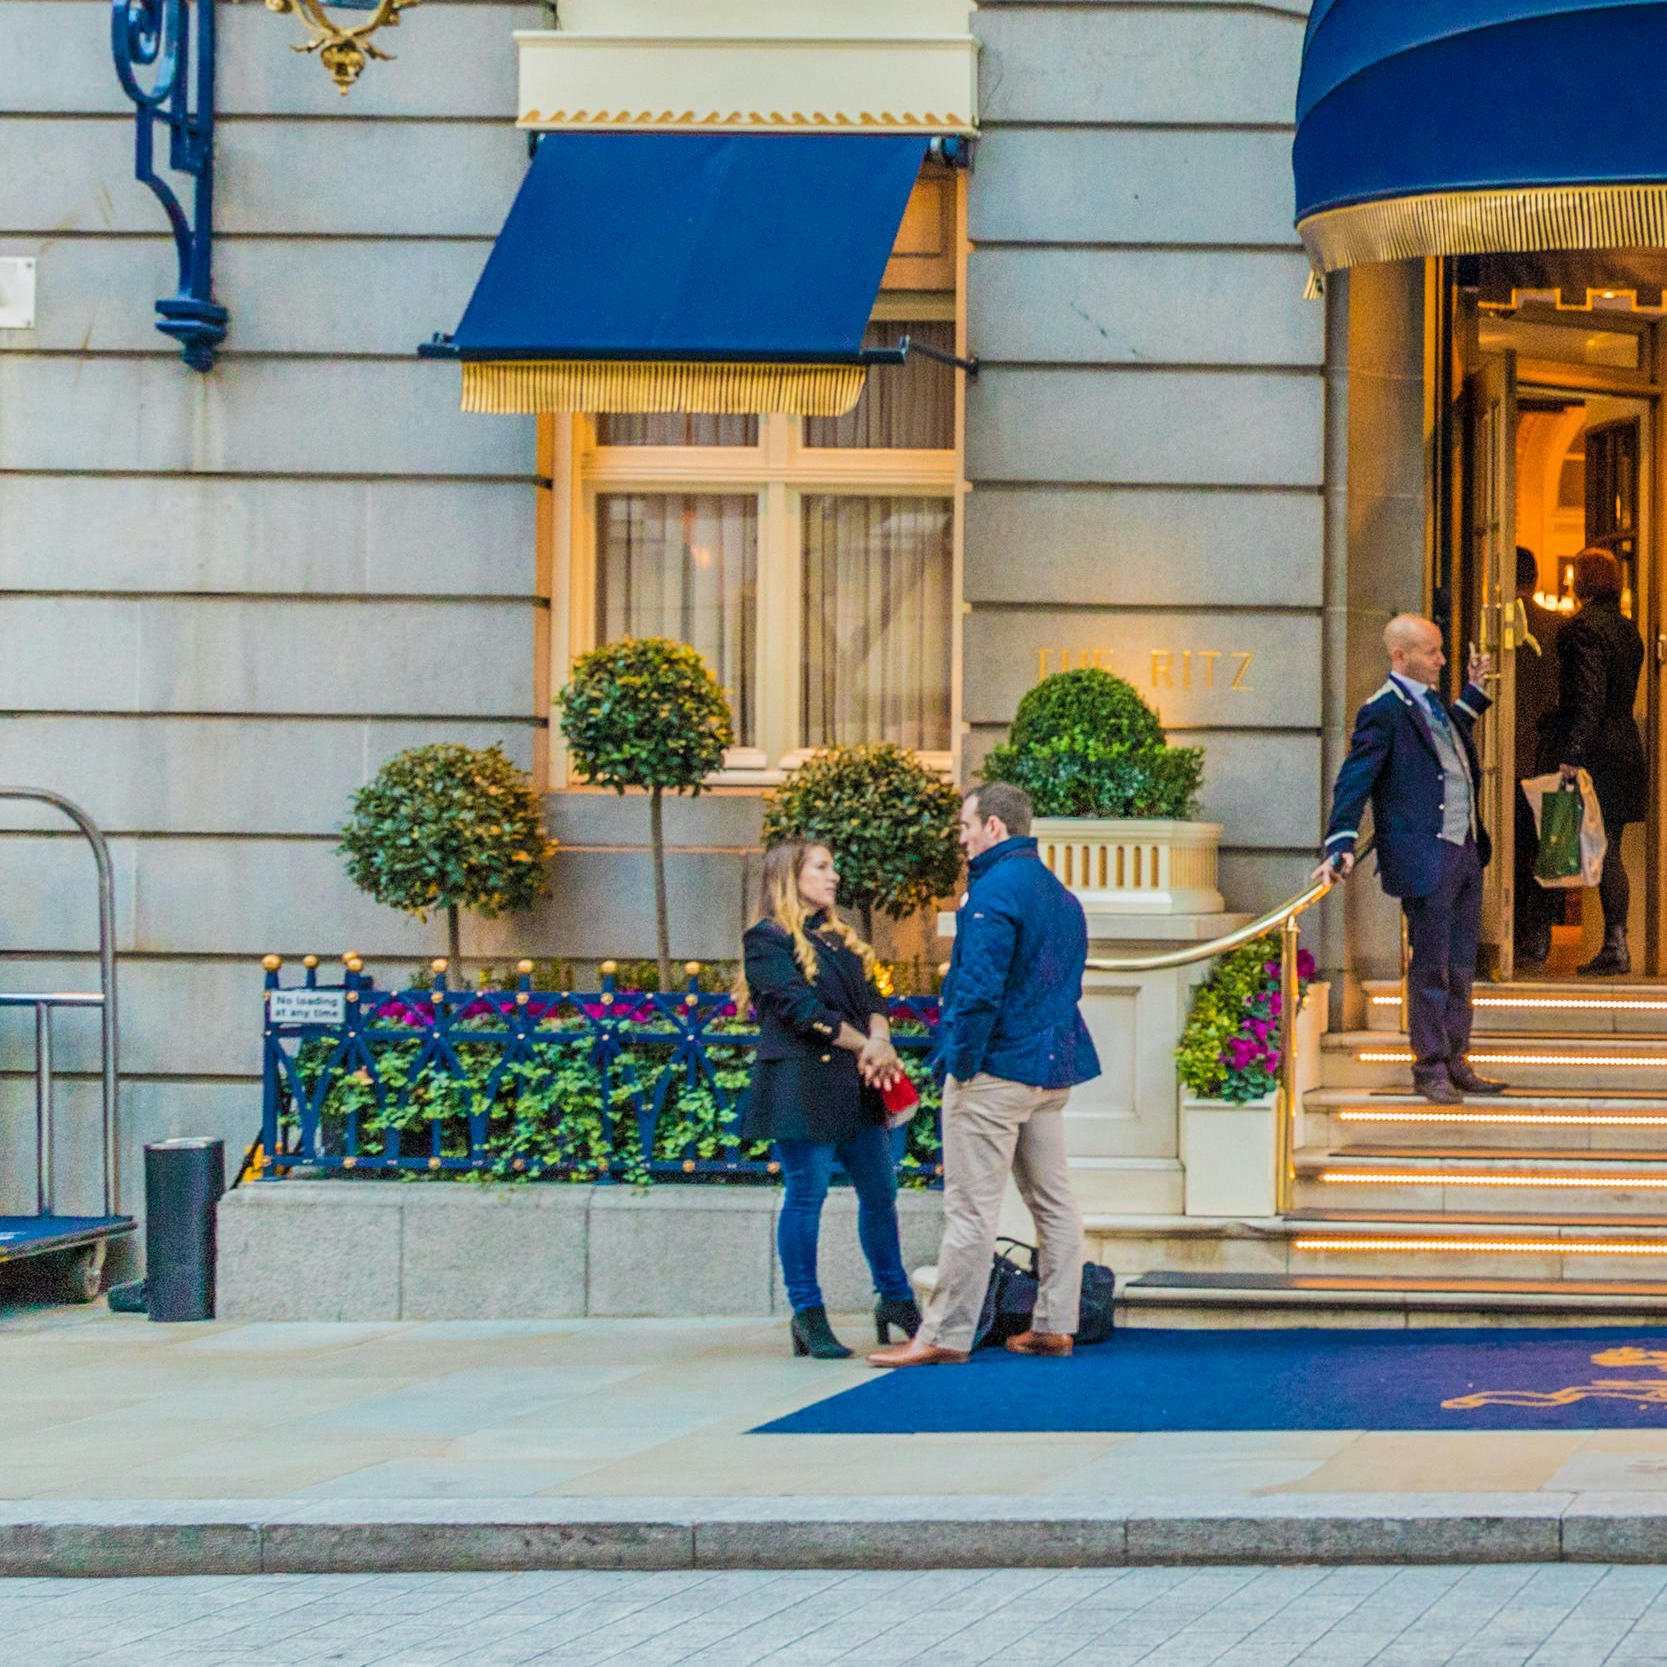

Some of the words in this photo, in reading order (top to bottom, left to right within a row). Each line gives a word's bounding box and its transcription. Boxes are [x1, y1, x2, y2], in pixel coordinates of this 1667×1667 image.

[1151, 649, 1254, 691] RITZ
[297, 996, 337, 1007] loading
[291, 1009, 309, 1018] any
[314, 1009, 338, 1017] time
